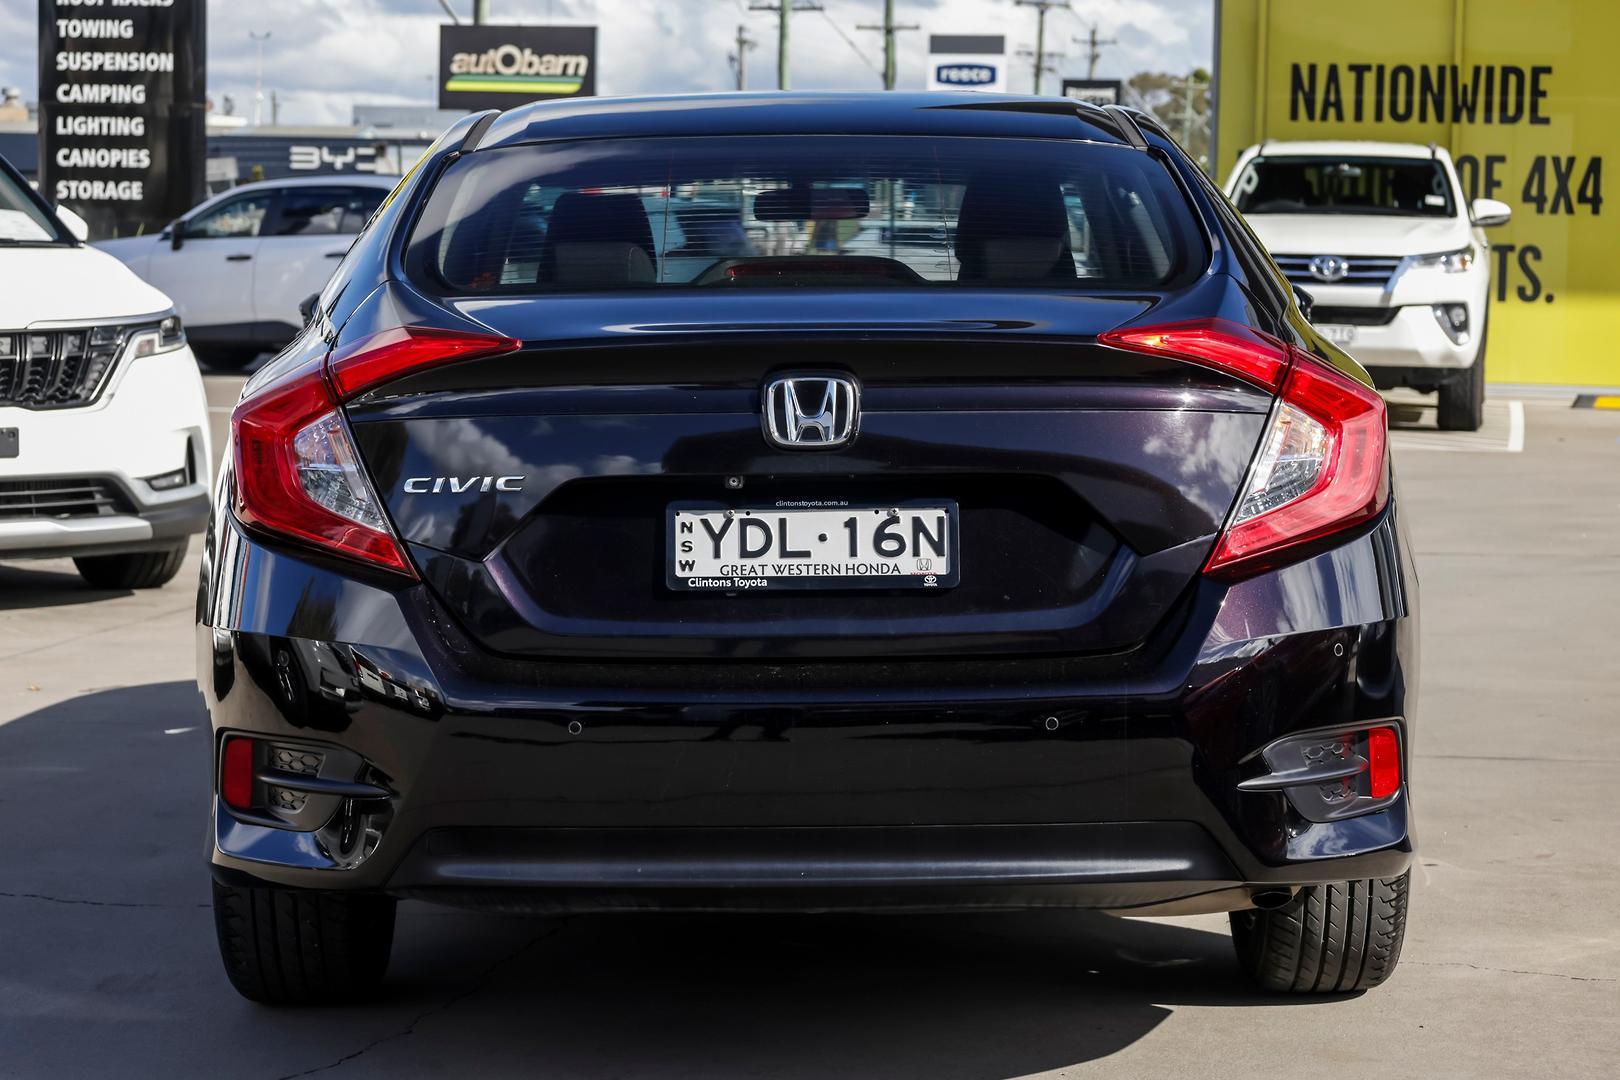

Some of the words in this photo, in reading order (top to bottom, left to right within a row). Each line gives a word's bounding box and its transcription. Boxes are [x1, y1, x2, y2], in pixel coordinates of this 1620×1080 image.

[56, 19, 134, 39] TOWING
[56, 52, 174, 72] SUSPENSION
[940, 67, 992, 83] reece
[56, 84, 146, 104] CAMPING
[1289, 63, 1553, 125] NATIONWIDE
[56, 116, 145, 136] LIGHTING
[56, 148, 151, 168] CANOPIES
[56, 181, 143, 201] STORAGE
[1521, 155, 1604, 216] 4X4
[403, 475, 526, 494] CIVIC
[775, 500, 849, 508] clintonstoyota.com.au
[719, 564, 768, 577] GREAT
[771, 564, 841, 576] WESTERN
[845, 563, 901, 575] HONDA
[687, 577, 732, 588] Clintons
[733, 577, 768, 589] Toyota
